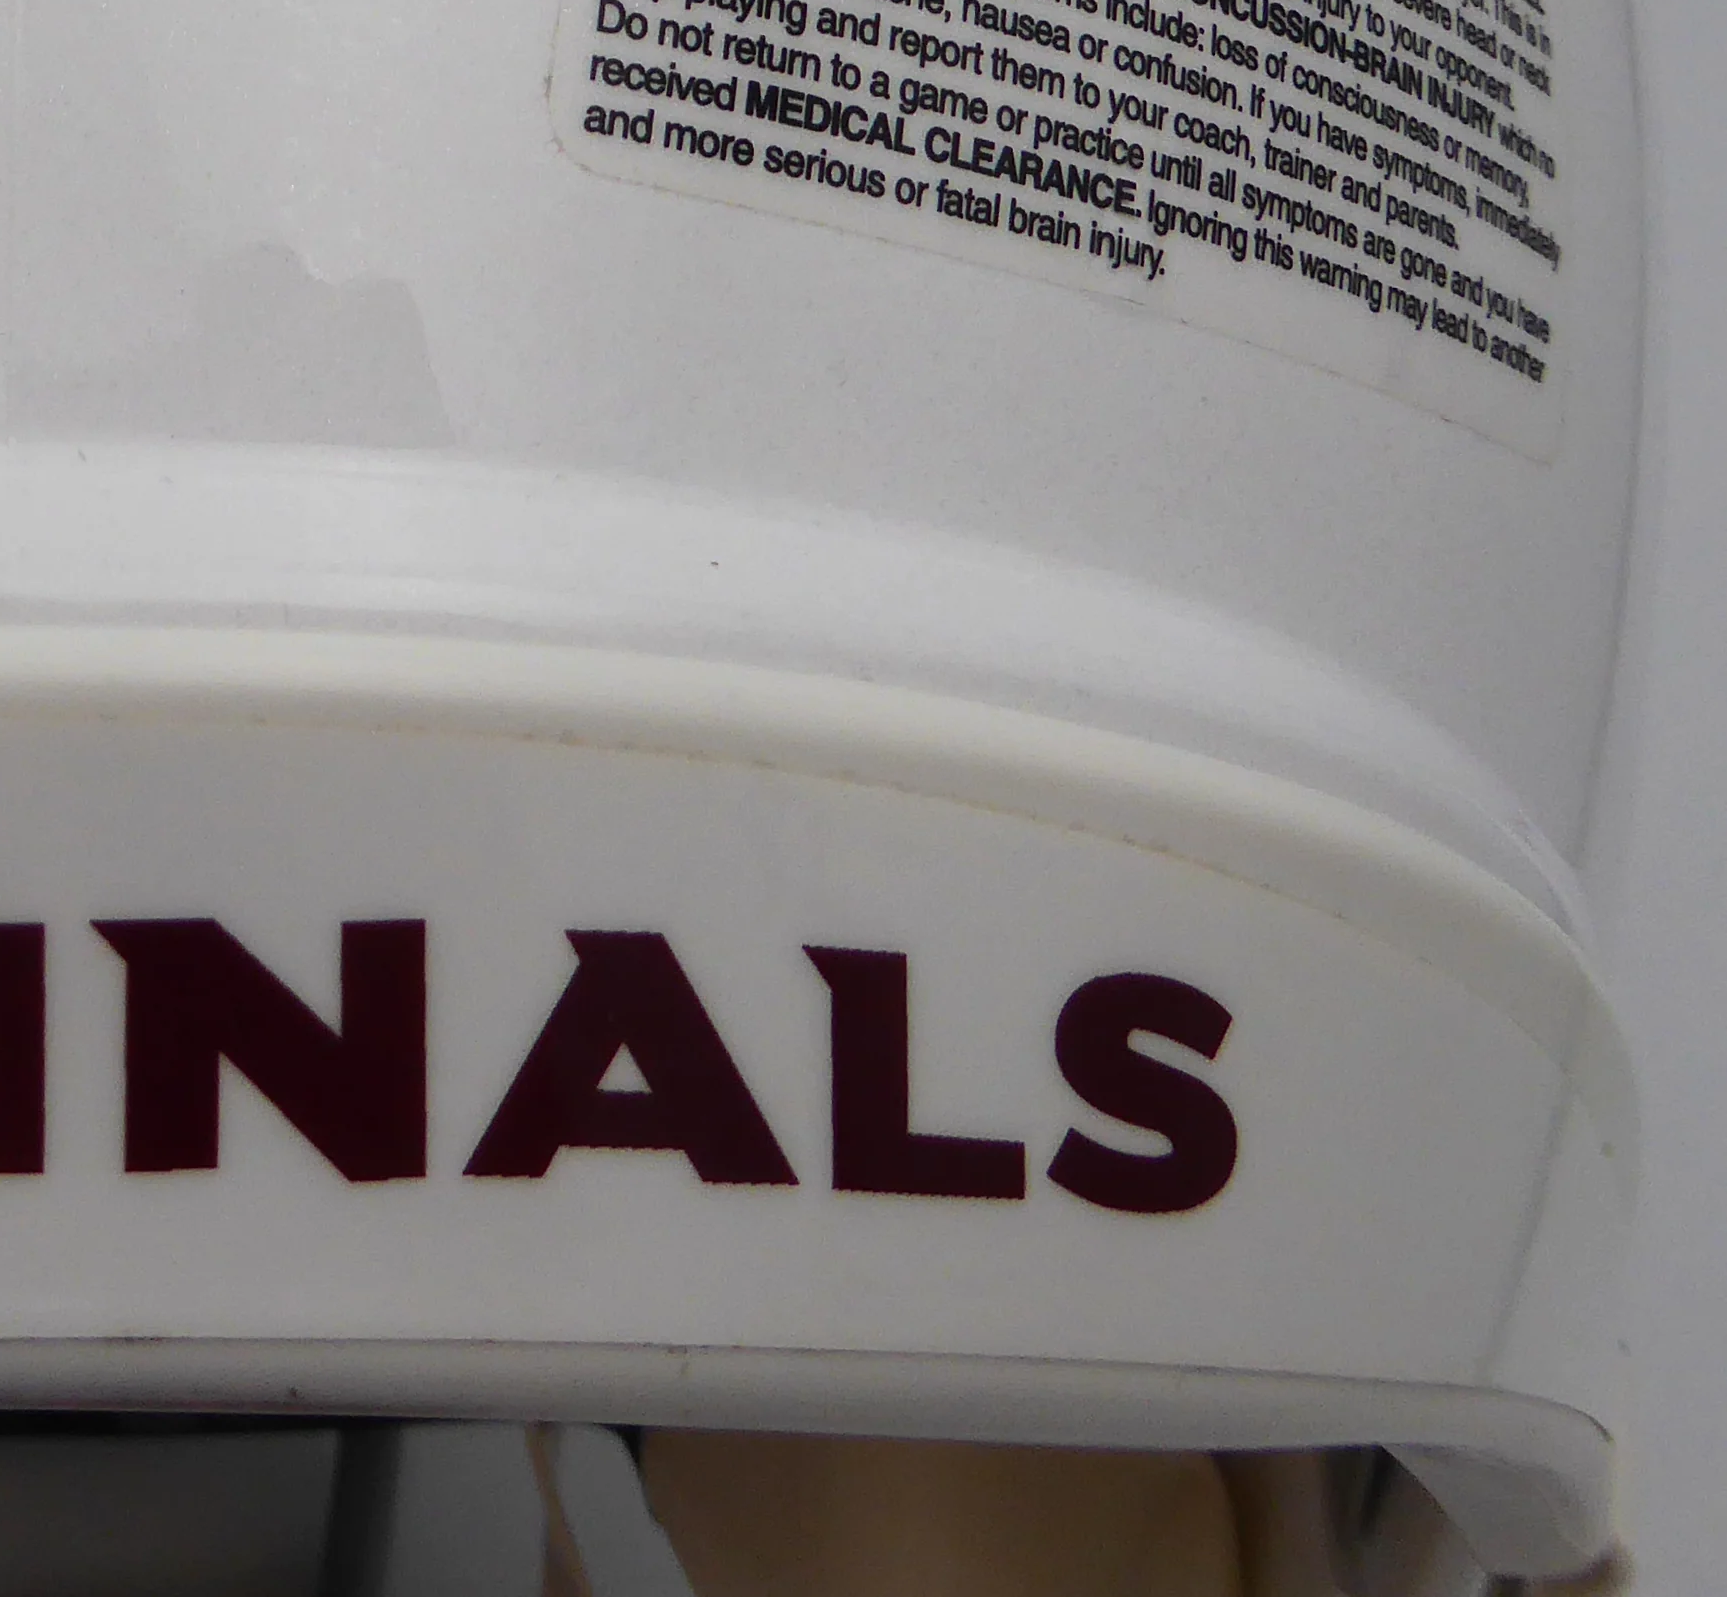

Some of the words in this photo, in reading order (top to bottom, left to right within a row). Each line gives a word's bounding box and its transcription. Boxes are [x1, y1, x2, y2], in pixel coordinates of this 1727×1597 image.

[1078, 34, 1109, 63] or
[1113, 44, 1243, 112] confusion.
[1250, 84, 1266, 118] If
[1269, 99, 1312, 137] you
[1317, 112, 1367, 162] have
[1372, 144, 1470, 217] symptoms,
[1210, 25, 1259, 71] loss
[1265, 51, 1288, 82] of
[1292, 64, 1440, 152] consciousness
[1443, 135, 1463, 162] or
[1366, 4, 1385, 37] to
[1390, 19, 1432, 60] your
[1435, 46, 1514, 112] opponent.
[1427, 74, 1496, 138] INJURY
[1456, 8, 1497, 59] head
[1500, 43, 1516, 68] or
[583, 105, 655, 144] and
[663, 120, 755, 166] more
[763, 145, 886, 198] serious
[895, 176, 929, 207] or
[936, 179, 1001, 227] fatal
[1008, 197, 1082, 250] brain
[1088, 220, 1165, 281] injury.
[658, 17, 715, 56] not
[722, 33, 822, 82] return
[831, 53, 862, 91] to
[870, 70, 890, 100] a
[899, 77, 989, 125] game
[996, 105, 1028, 135] or
[1033, 115, 1145, 170] practice
[1150, 150, 1203, 192] until
[1208, 168, 1236, 203] all
[1241, 183, 1358, 249] symptoms
[1363, 230, 1395, 264] are
[1400, 246, 1448, 287] gone
[1451, 270, 1484, 306] and
[1485, 287, 1514, 324] you
[1517, 297, 1550, 344] have
[816, 7, 881, 47] and
[888, 25, 983, 75] report
[991, 48, 1065, 98] them
[1074, 73, 1101, 108] to
[1108, 88, 1169, 131] your
[1174, 112, 1256, 168] coach,
[1264, 138, 1337, 193] trainer
[1341, 175, 1382, 213] and
[1385, 194, 1460, 250] parents.
[590, 55, 738, 112] received
[745, 80, 916, 155] MEDICAL
[925, 126, 1142, 218] CLEARANCE.
[1147, 189, 1248, 262] Ignoring
[1254, 228, 1293, 270] this
[1299, 250, 1382, 313] warning
[1387, 286, 1428, 331] may
[1432, 297, 1469, 343] lead
[1472, 319, 1488, 352] to
[1490, 334, 1545, 383] another
